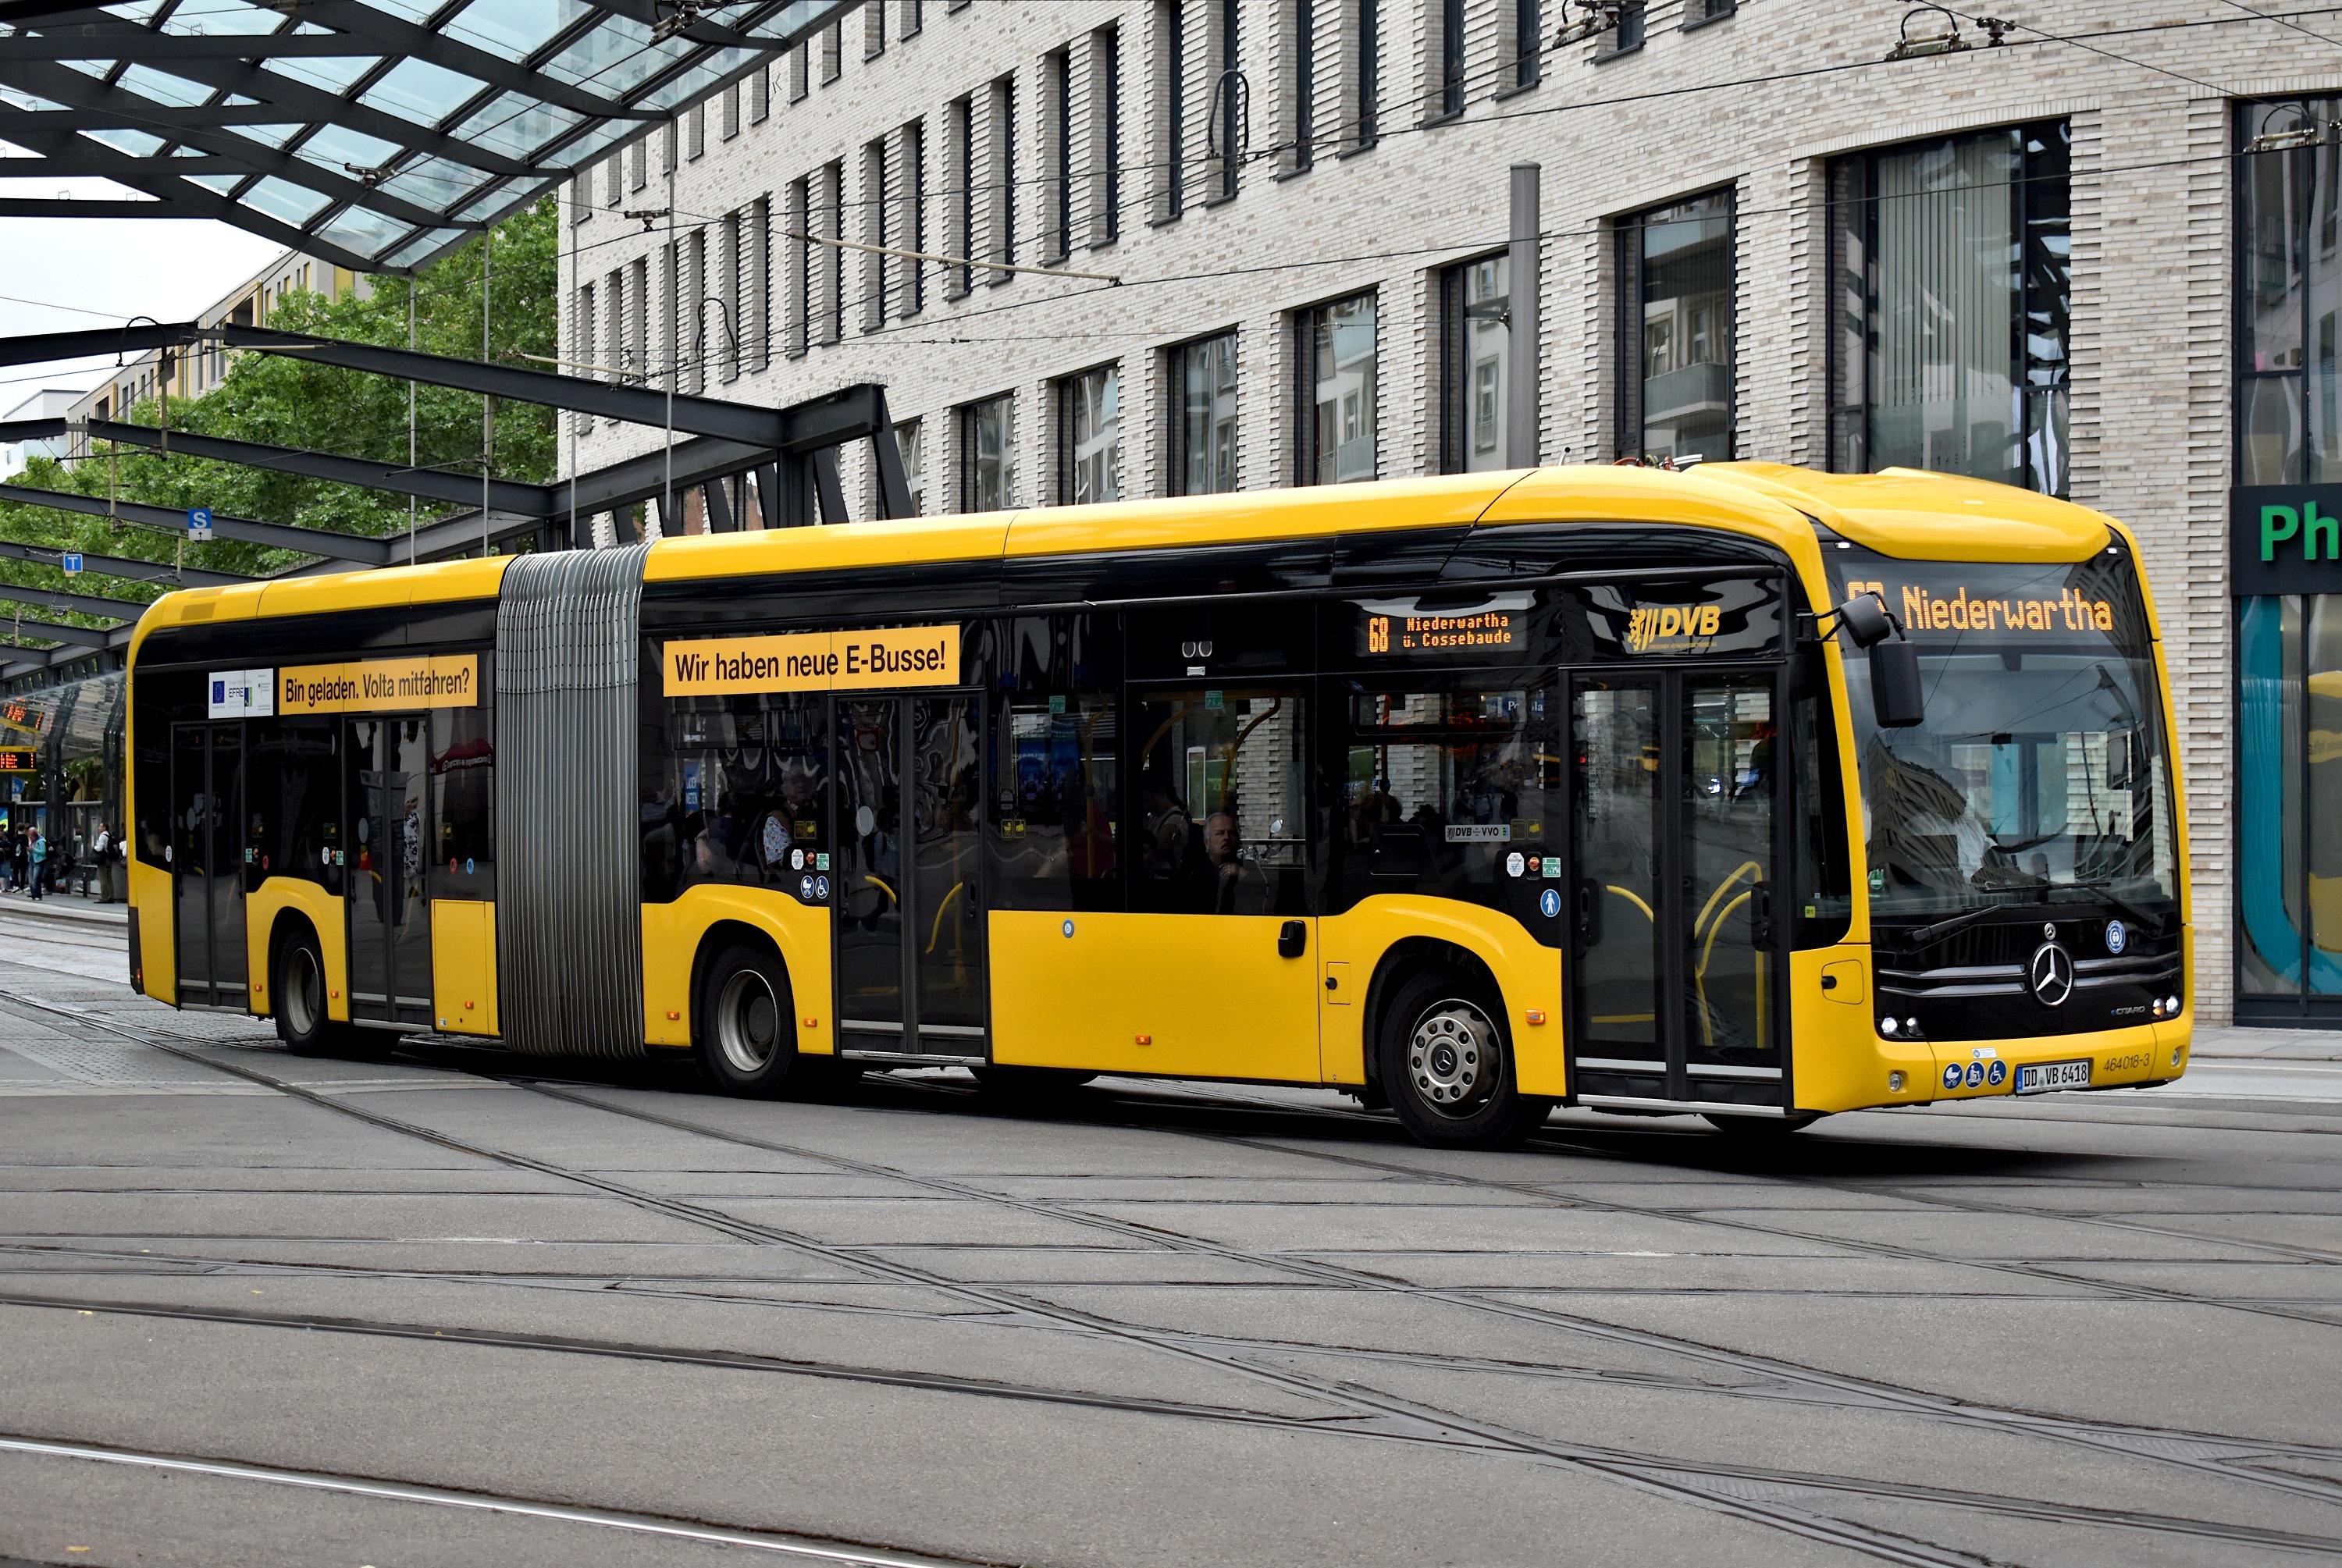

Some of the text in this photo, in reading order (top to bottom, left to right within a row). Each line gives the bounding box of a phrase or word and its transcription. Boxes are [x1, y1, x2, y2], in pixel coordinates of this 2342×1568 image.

[193, 512, 208, 528] S
[2261, 500, 2340, 561] Ph
[68, 556, 78, 570] T
[1902, 585, 2112, 631] Niederwartha
[1369, 613, 1508, 653] 68 Niederwartha
[1659, 606, 1721, 637] DVB
[1403, 629, 1512, 648] ü. Cossebaude
[675, 640, 946, 682] Wir haben neue E-Busse!
[229, 687, 244, 698] EFRE
[286, 667, 470, 707] Bin geladen. Volta mitfahren?
[1455, 827, 1472, 837] DVB
[1482, 827, 1499, 837] VVO
[2103, 1053, 2150, 1072] 464018-3
[2024, 1064, 2087, 1087] DD VB 6418
